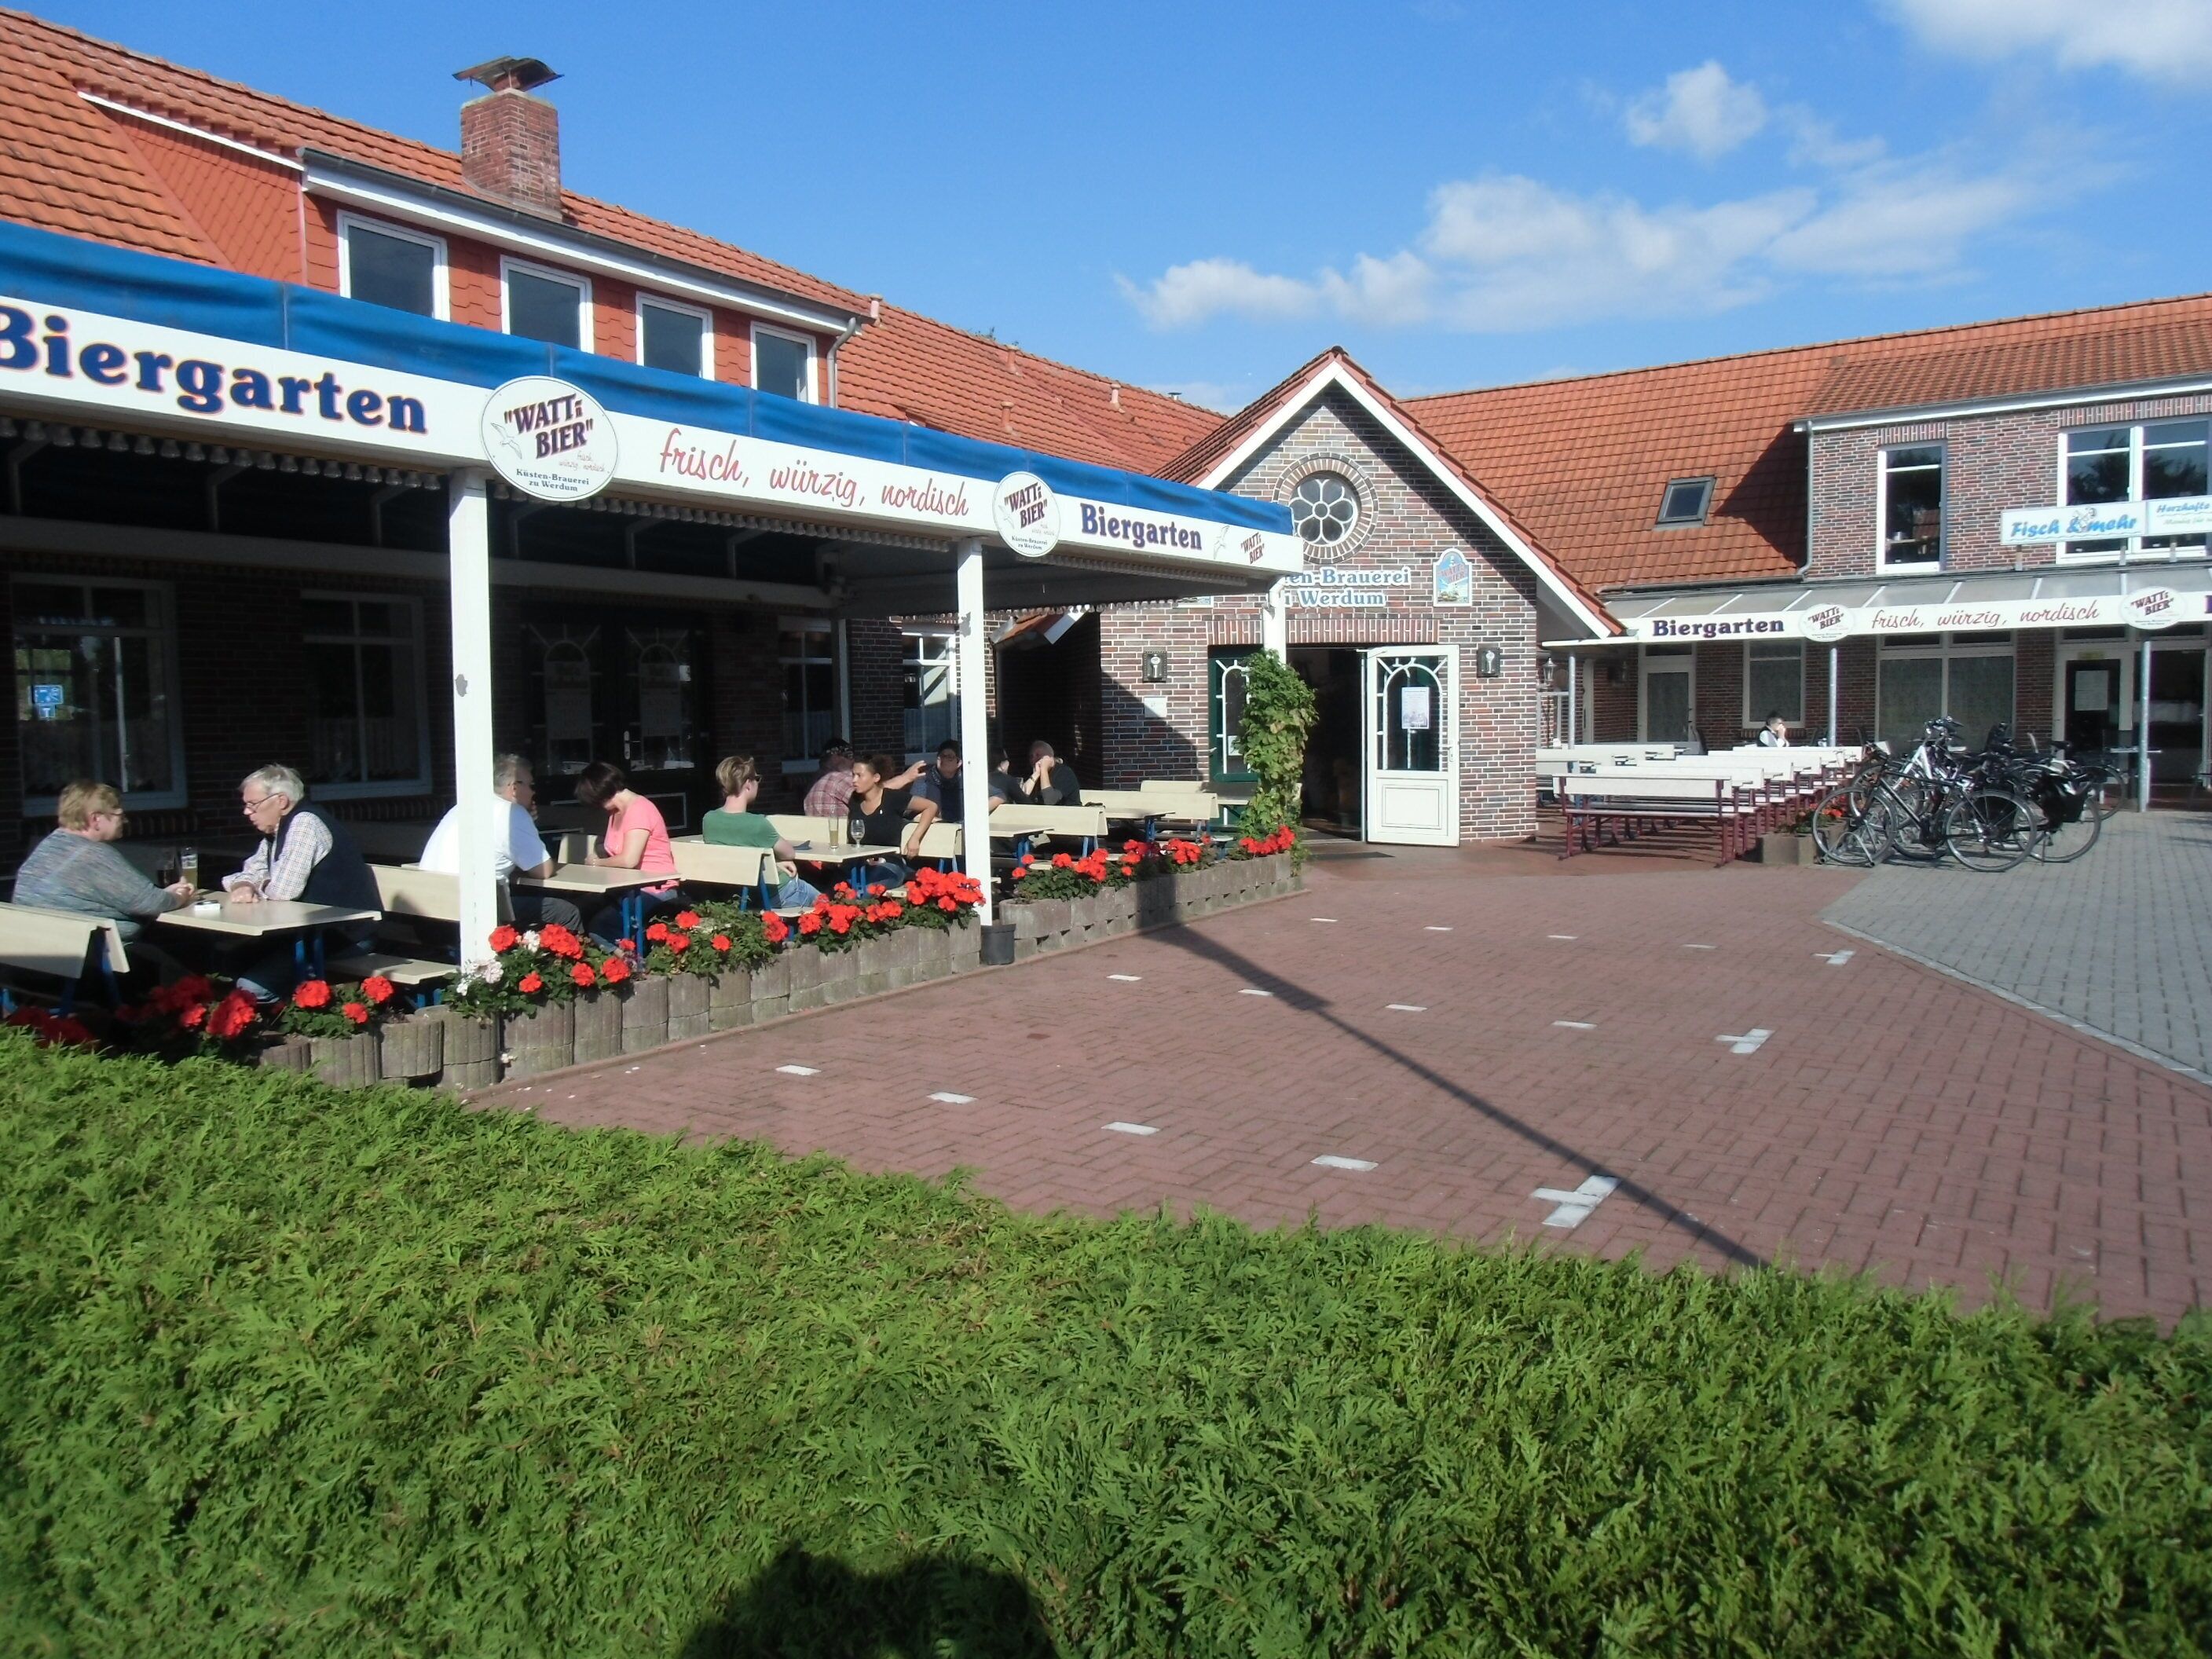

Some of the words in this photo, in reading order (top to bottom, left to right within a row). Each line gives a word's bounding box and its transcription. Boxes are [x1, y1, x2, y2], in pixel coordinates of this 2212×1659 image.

[0, 304, 427, 434] Biergarten
[516, 469, 590, 485] Küsten-Brauerei
[659, 427, 749, 488] frisch,
[770, 459, 866, 507] würzig,
[881, 478, 969, 517] nordisch
[542, 481, 578, 492] Werdum
[1080, 503, 1203, 551] Biergarten
[2011, 518, 2060, 537] Fisch
[2067, 515, 2081, 533] &
[2086, 514, 2137, 533] mehr
[1285, 569, 1410, 584] en-Brauerei
[1300, 588, 1385, 606] Werdum
[1872, 608, 1925, 629] frisch,
[1937, 610, 2008, 628] würzig,
[2020, 599, 2100, 622] nordisch
[1652, 619, 1785, 638] Biergarten
